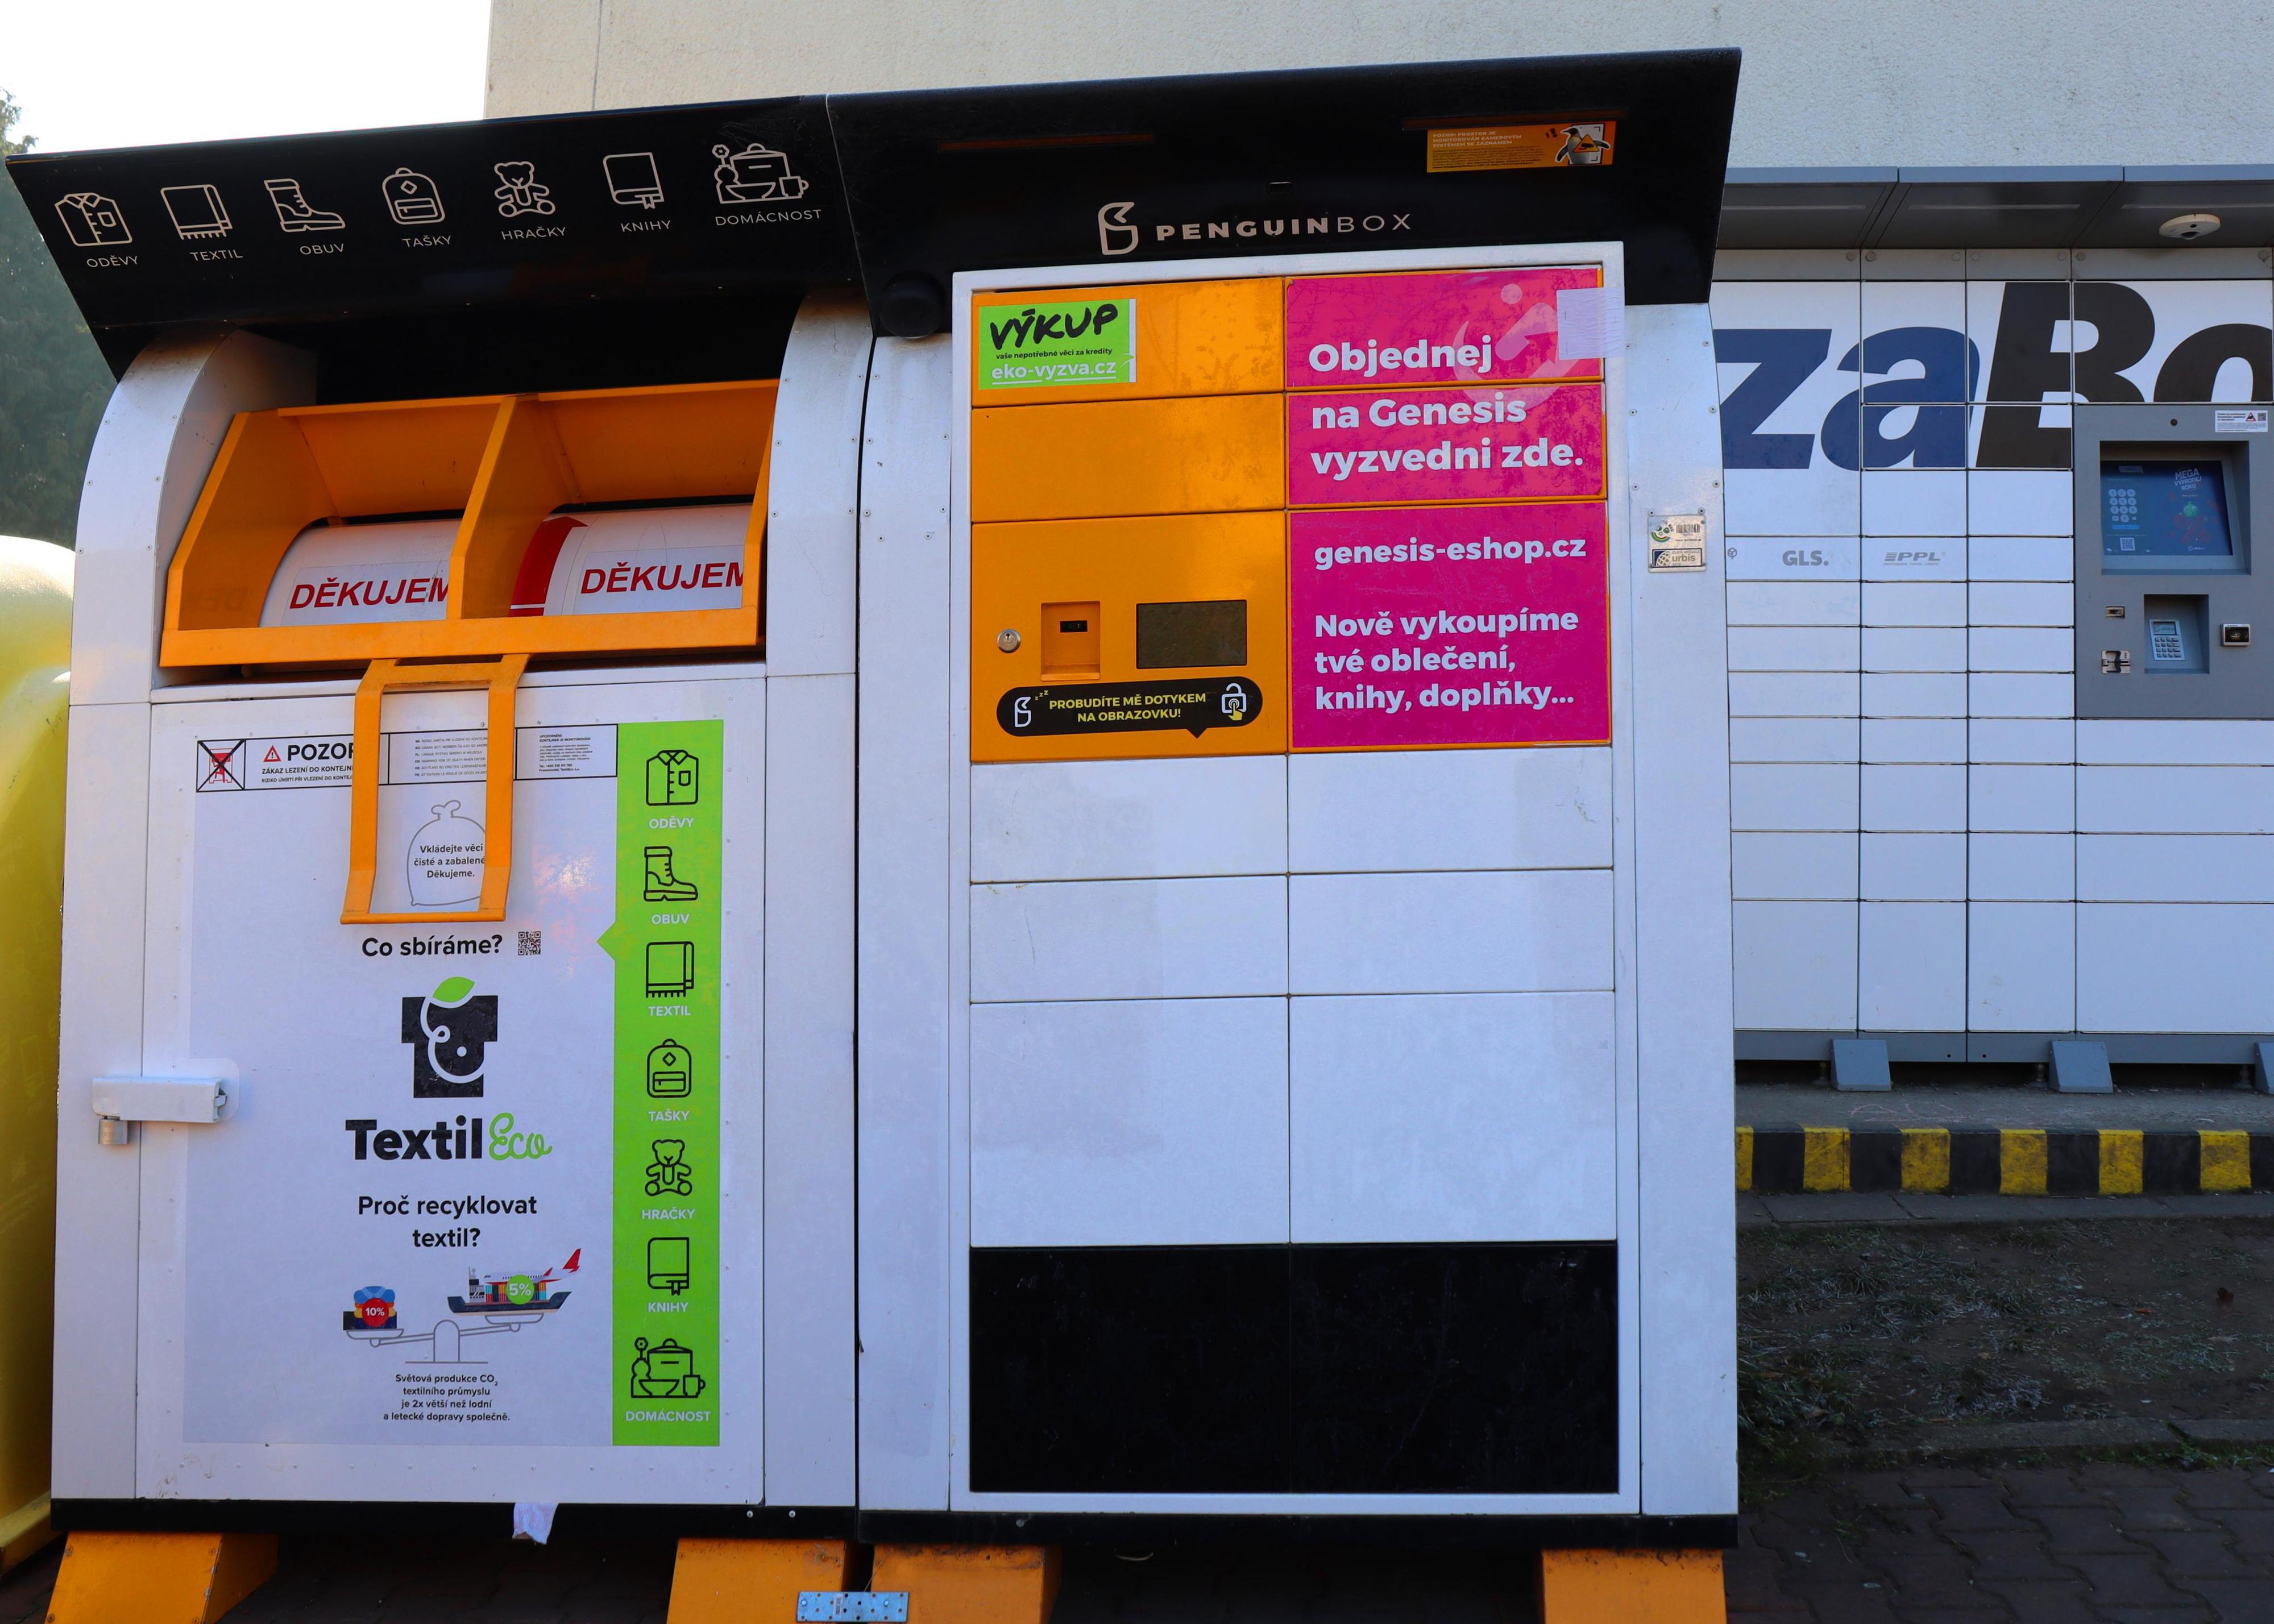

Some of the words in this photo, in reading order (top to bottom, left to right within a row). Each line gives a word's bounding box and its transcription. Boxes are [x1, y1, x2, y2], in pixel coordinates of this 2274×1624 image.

[715, 209, 822, 226] DOMÁCNOST
[621, 219, 671, 232] KNIHY
[1156, 214, 1410, 241] PENGUINBOX
[501, 226, 566, 241] HRAČKY
[402, 235, 452, 248] TAŠKY
[190, 249, 243, 261] TEXTIL
[300, 243, 345, 256] OBUV
[86, 255, 138, 268] ODĚVY
[990, 304, 1118, 350] VÝKUP
[1014, 351, 1057, 360] nepotřebné
[1309, 334, 1492, 377] Objednej
[991, 362, 1117, 381] eko-vyzva.cz
[1312, 406, 1359, 429] na
[1368, 392, 1528, 428] Genesis
[1310, 437, 1491, 481] vyzvedni
[1501, 438, 1584, 469] zde.
[1314, 536, 1586, 571] genesis-eshop.cz
[1898, 552, 1941, 561] PPL
[1315, 610, 1394, 637] Nově
[1400, 607, 1579, 640] vykoupíme
[1314, 649, 1364, 674] tvé
[1371, 645, 1516, 673] oblečení,
[1049, 696, 1120, 709] PROBUDÍTE
[1123, 694, 1142, 706] MĚ
[1145, 693, 1206, 705] DOTYKEM
[1316, 684, 1412, 714] knihy,
[1419, 680, 1574, 712] doplňky...
[1077, 713, 1096, 722] NA
[1098, 709, 1181, 721] OBRAZOVKU!
[649, 815, 695, 830] ODĚVY
[420, 844, 462, 854] Vkládejte
[414, 857, 435, 866] čisté
[427, 870, 475, 879] Děkujeme.
[652, 914, 690, 925] OBUV
[362, 937, 393, 957] Co
[400, 934, 503, 956] sbíráme?
[648, 1006, 691, 1016] TEXTIL
[648, 1108, 690, 1122] TAŠKY
[358, 1195, 410, 1216] Proč
[417, 1195, 537, 1220] recyklovat
[641, 1207, 695, 1220] HRAČKY
[412, 1227, 481, 1248] textil?
[509, 1282, 532, 1296] 5%
[365, 1307, 385, 1317] 10%
[648, 1302, 689, 1313] KNIHY
[395, 1373, 431, 1382] Světová
[434, 1374, 477, 1384] produkce
[448, 1387, 490, 1397] průmyslu
[401, 1399, 410, 1409] je
[426, 1399, 448, 1407] větší
[469, 1399, 492, 1408] lodní
[391, 1411, 424, 1420] letecké
[426, 1413, 464, 1422] dopravy
[466, 1412, 510, 1422] společně.
[625, 1409, 711, 1422] DOMÁCNOST
